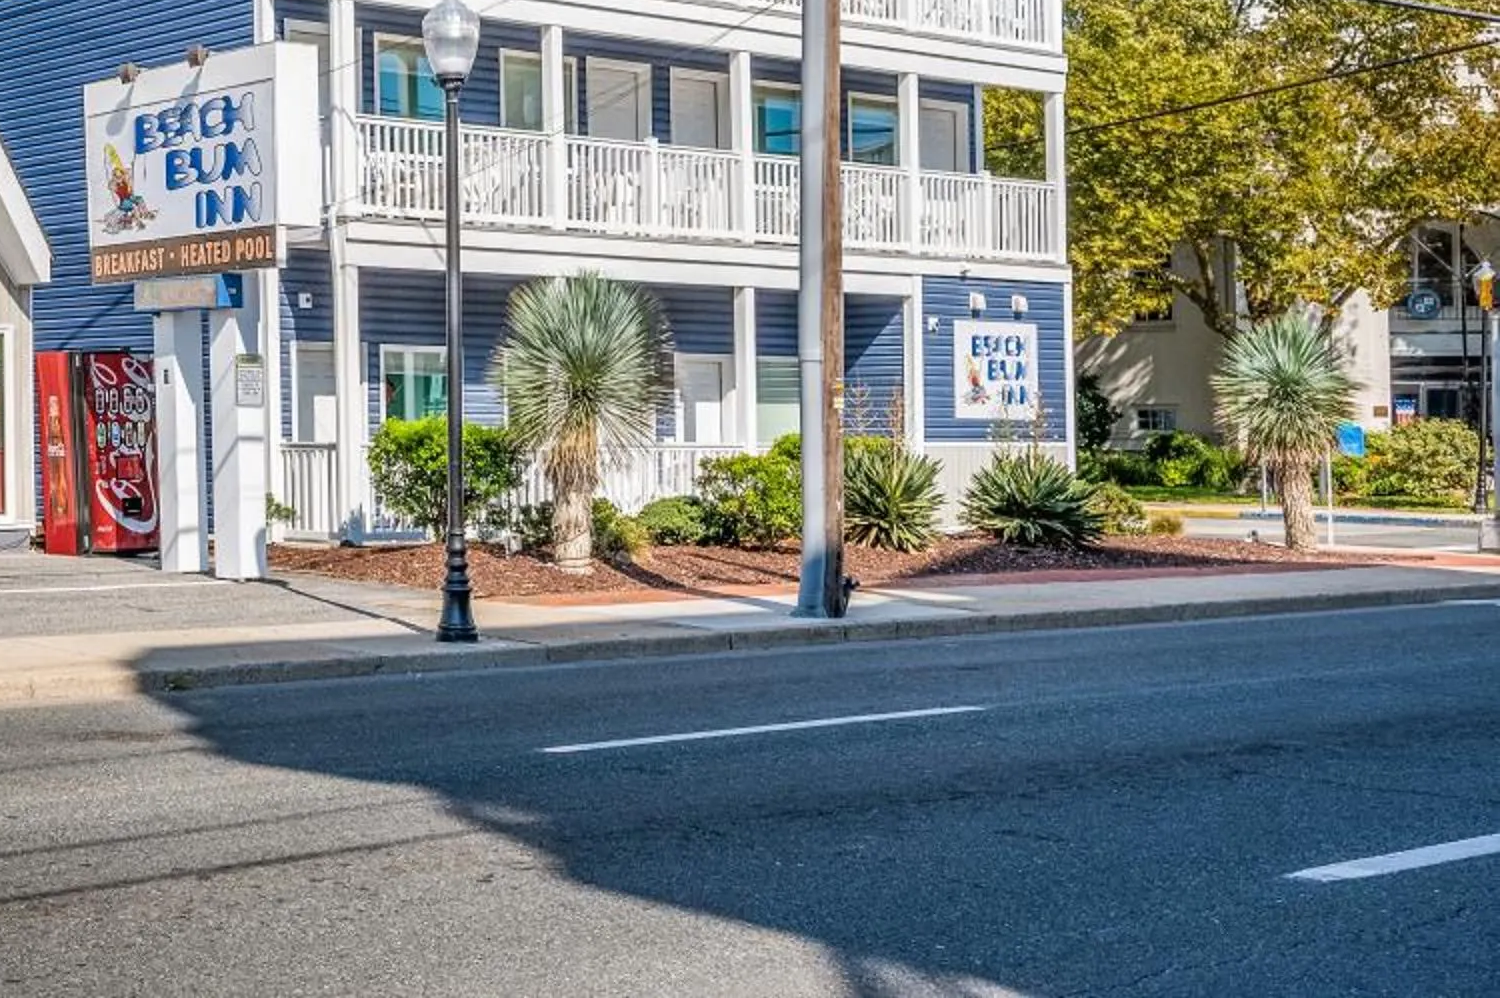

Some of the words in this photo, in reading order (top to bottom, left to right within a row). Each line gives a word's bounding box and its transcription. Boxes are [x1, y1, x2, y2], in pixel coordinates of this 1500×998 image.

[135, 91, 255, 154] BEACH
[166, 138, 262, 190] BUM
[195, 181, 262, 228] INN
[95, 247, 164, 277] BREAKFAST
[181, 239, 231, 267] HEATED
[235, 235, 273, 261] POOL
